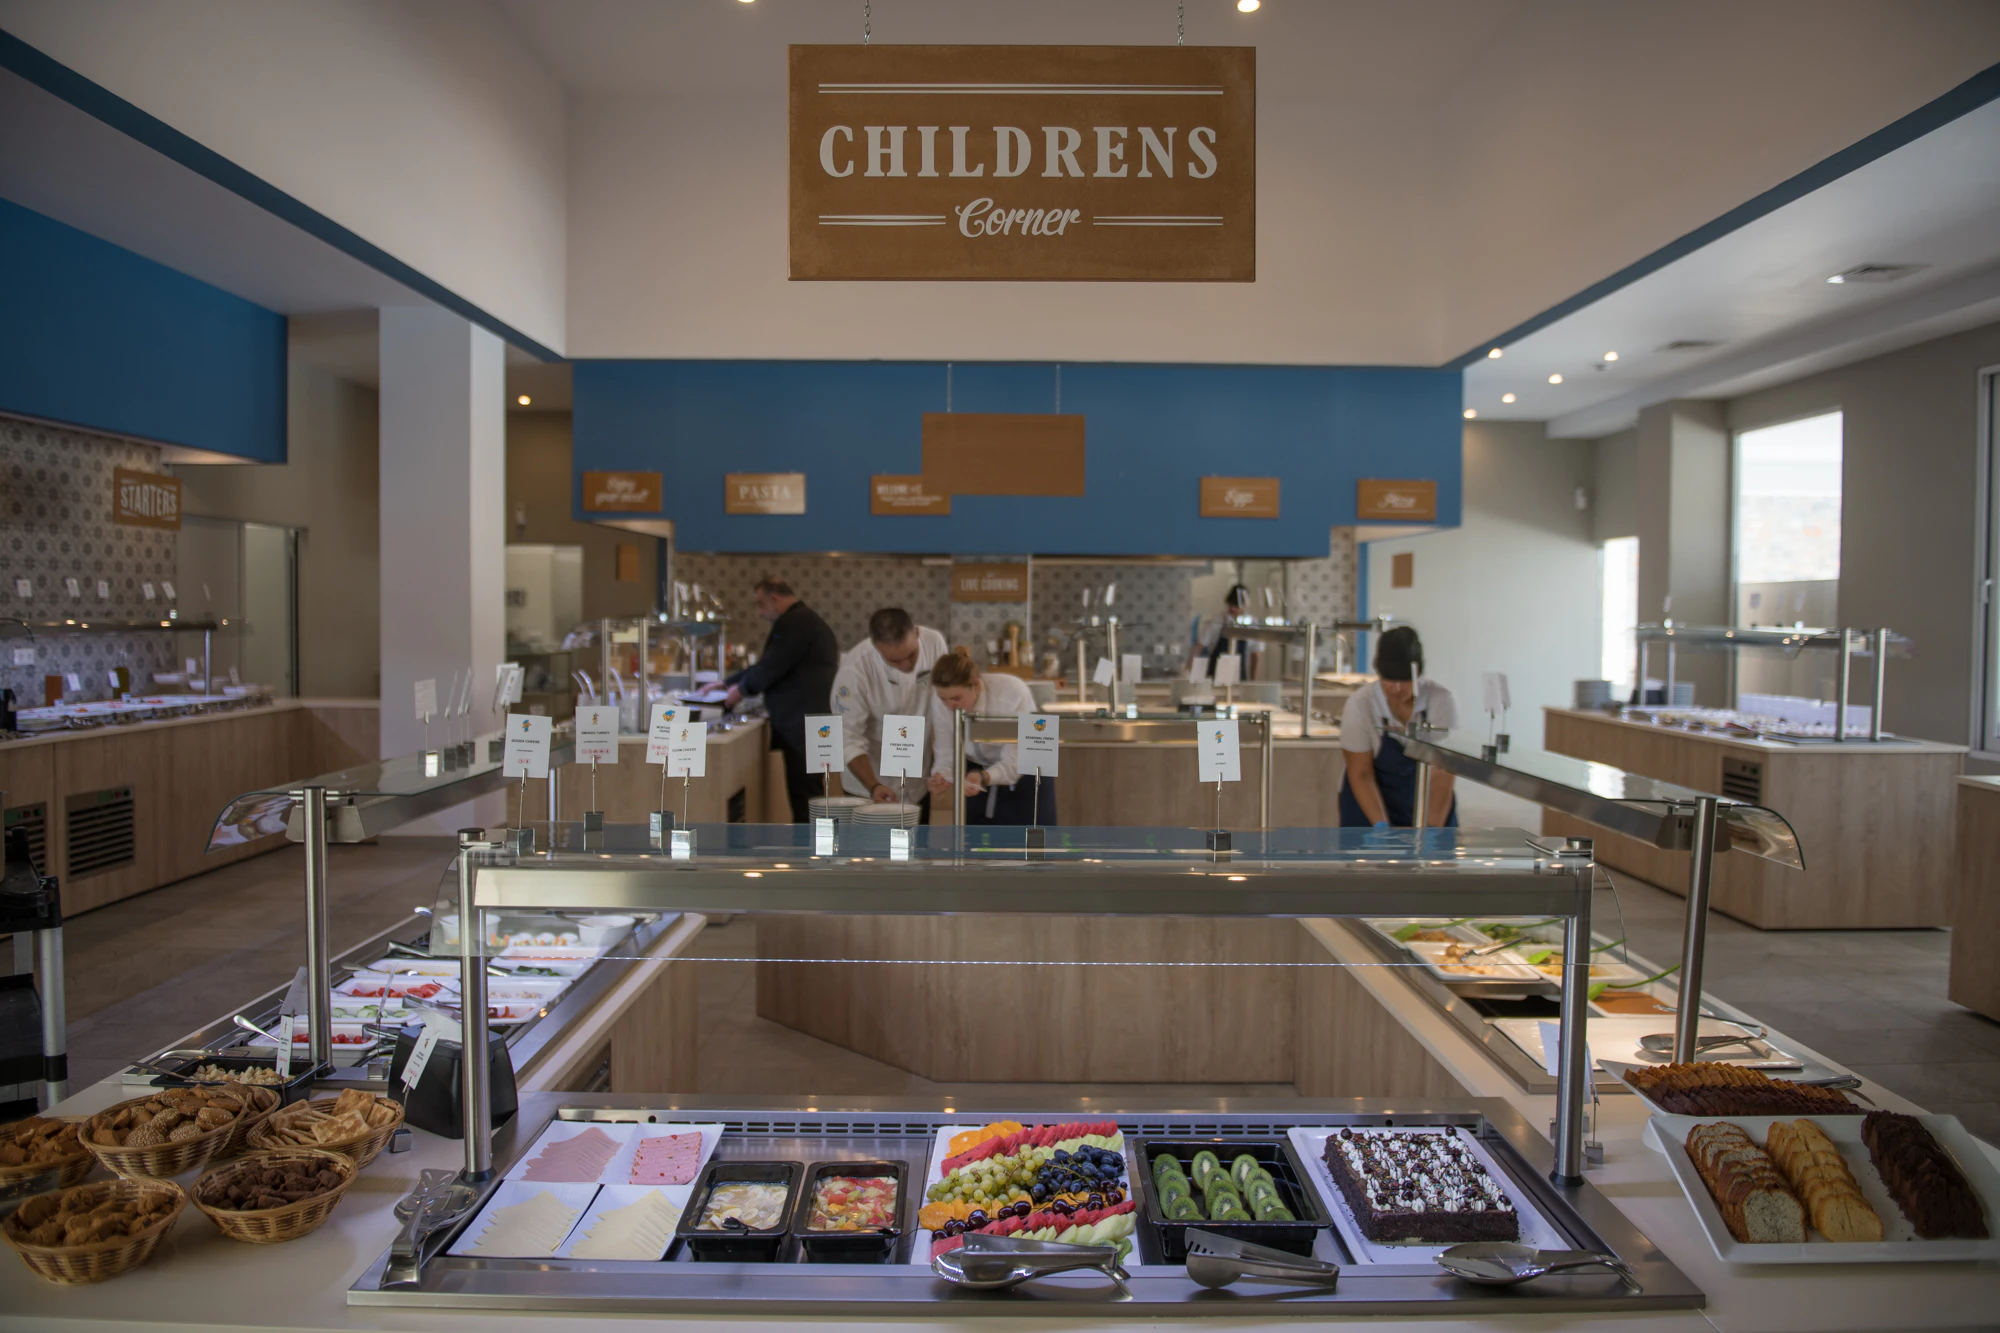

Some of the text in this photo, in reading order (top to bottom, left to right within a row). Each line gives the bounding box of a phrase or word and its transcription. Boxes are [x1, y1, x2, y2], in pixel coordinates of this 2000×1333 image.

[819, 124, 1218, 179] CHILDRENS
[955, 197, 1082, 238] Corner
[120, 484, 177, 518] STARTERS
[738, 485, 791, 500] PASTA
[960, 578, 1019, 592] LIVE COOKING
